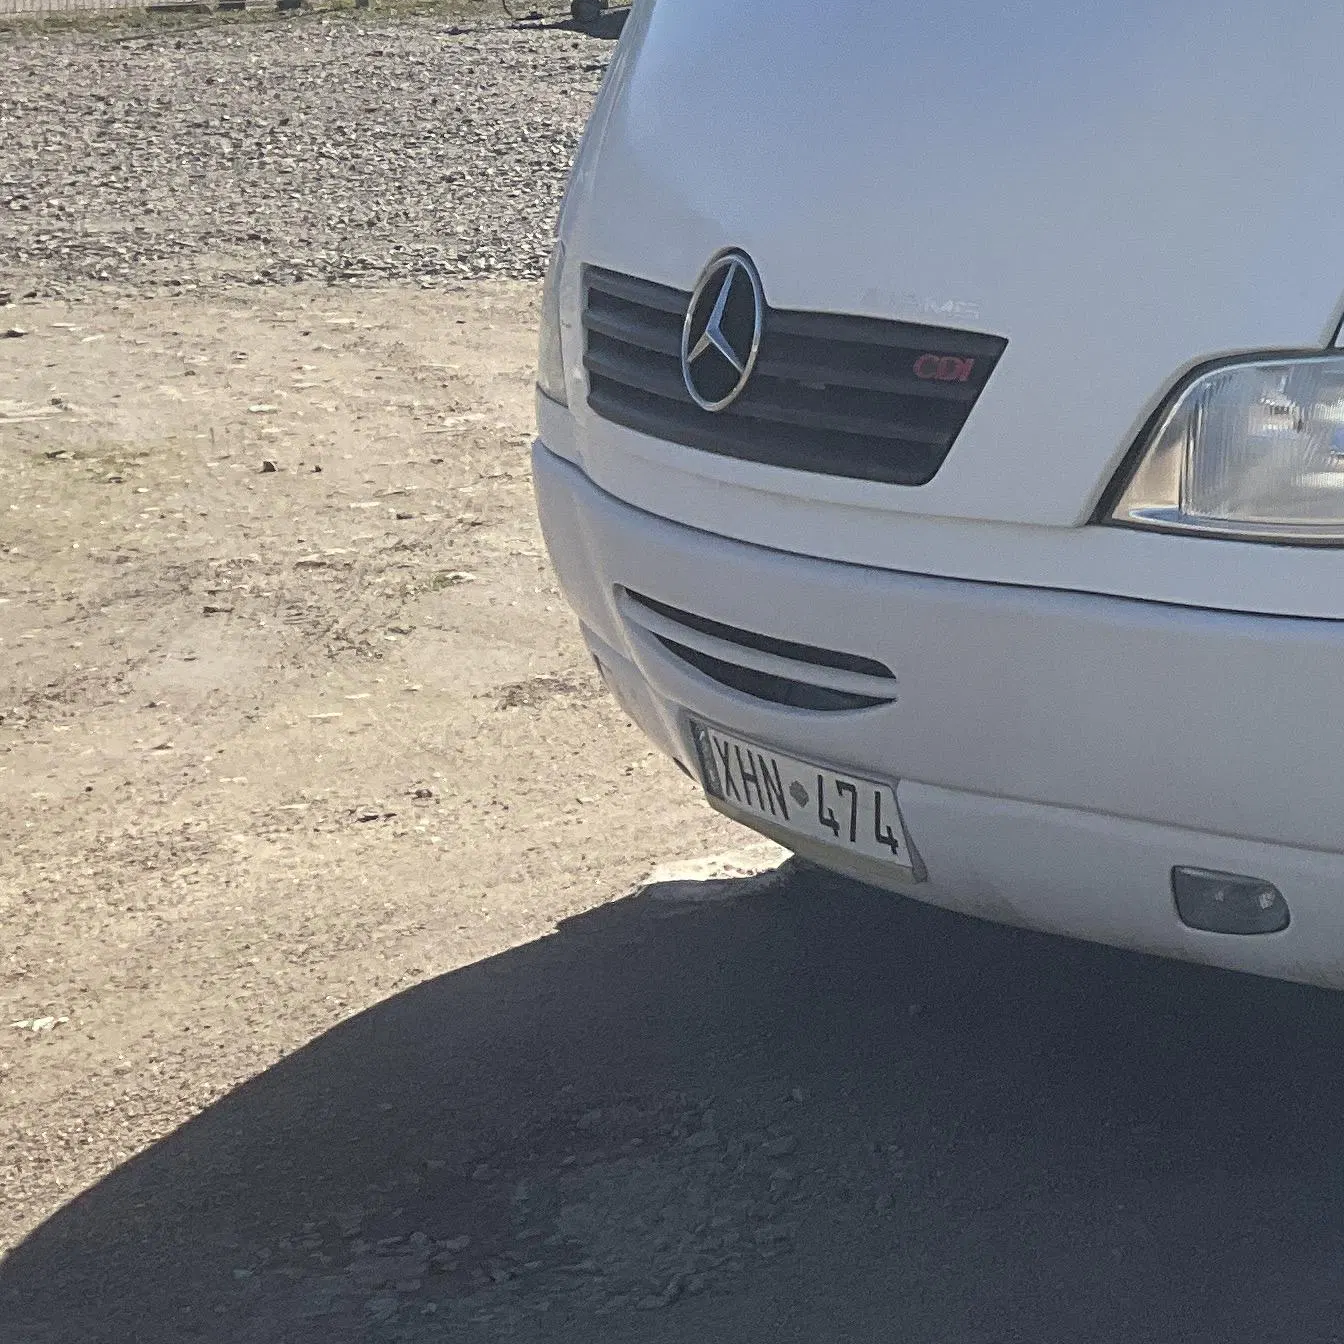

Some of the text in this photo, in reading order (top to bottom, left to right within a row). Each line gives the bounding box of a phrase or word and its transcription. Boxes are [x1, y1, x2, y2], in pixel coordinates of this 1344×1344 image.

[913, 353, 975, 382] CDI
[713, 735, 899, 855] XHN 474
